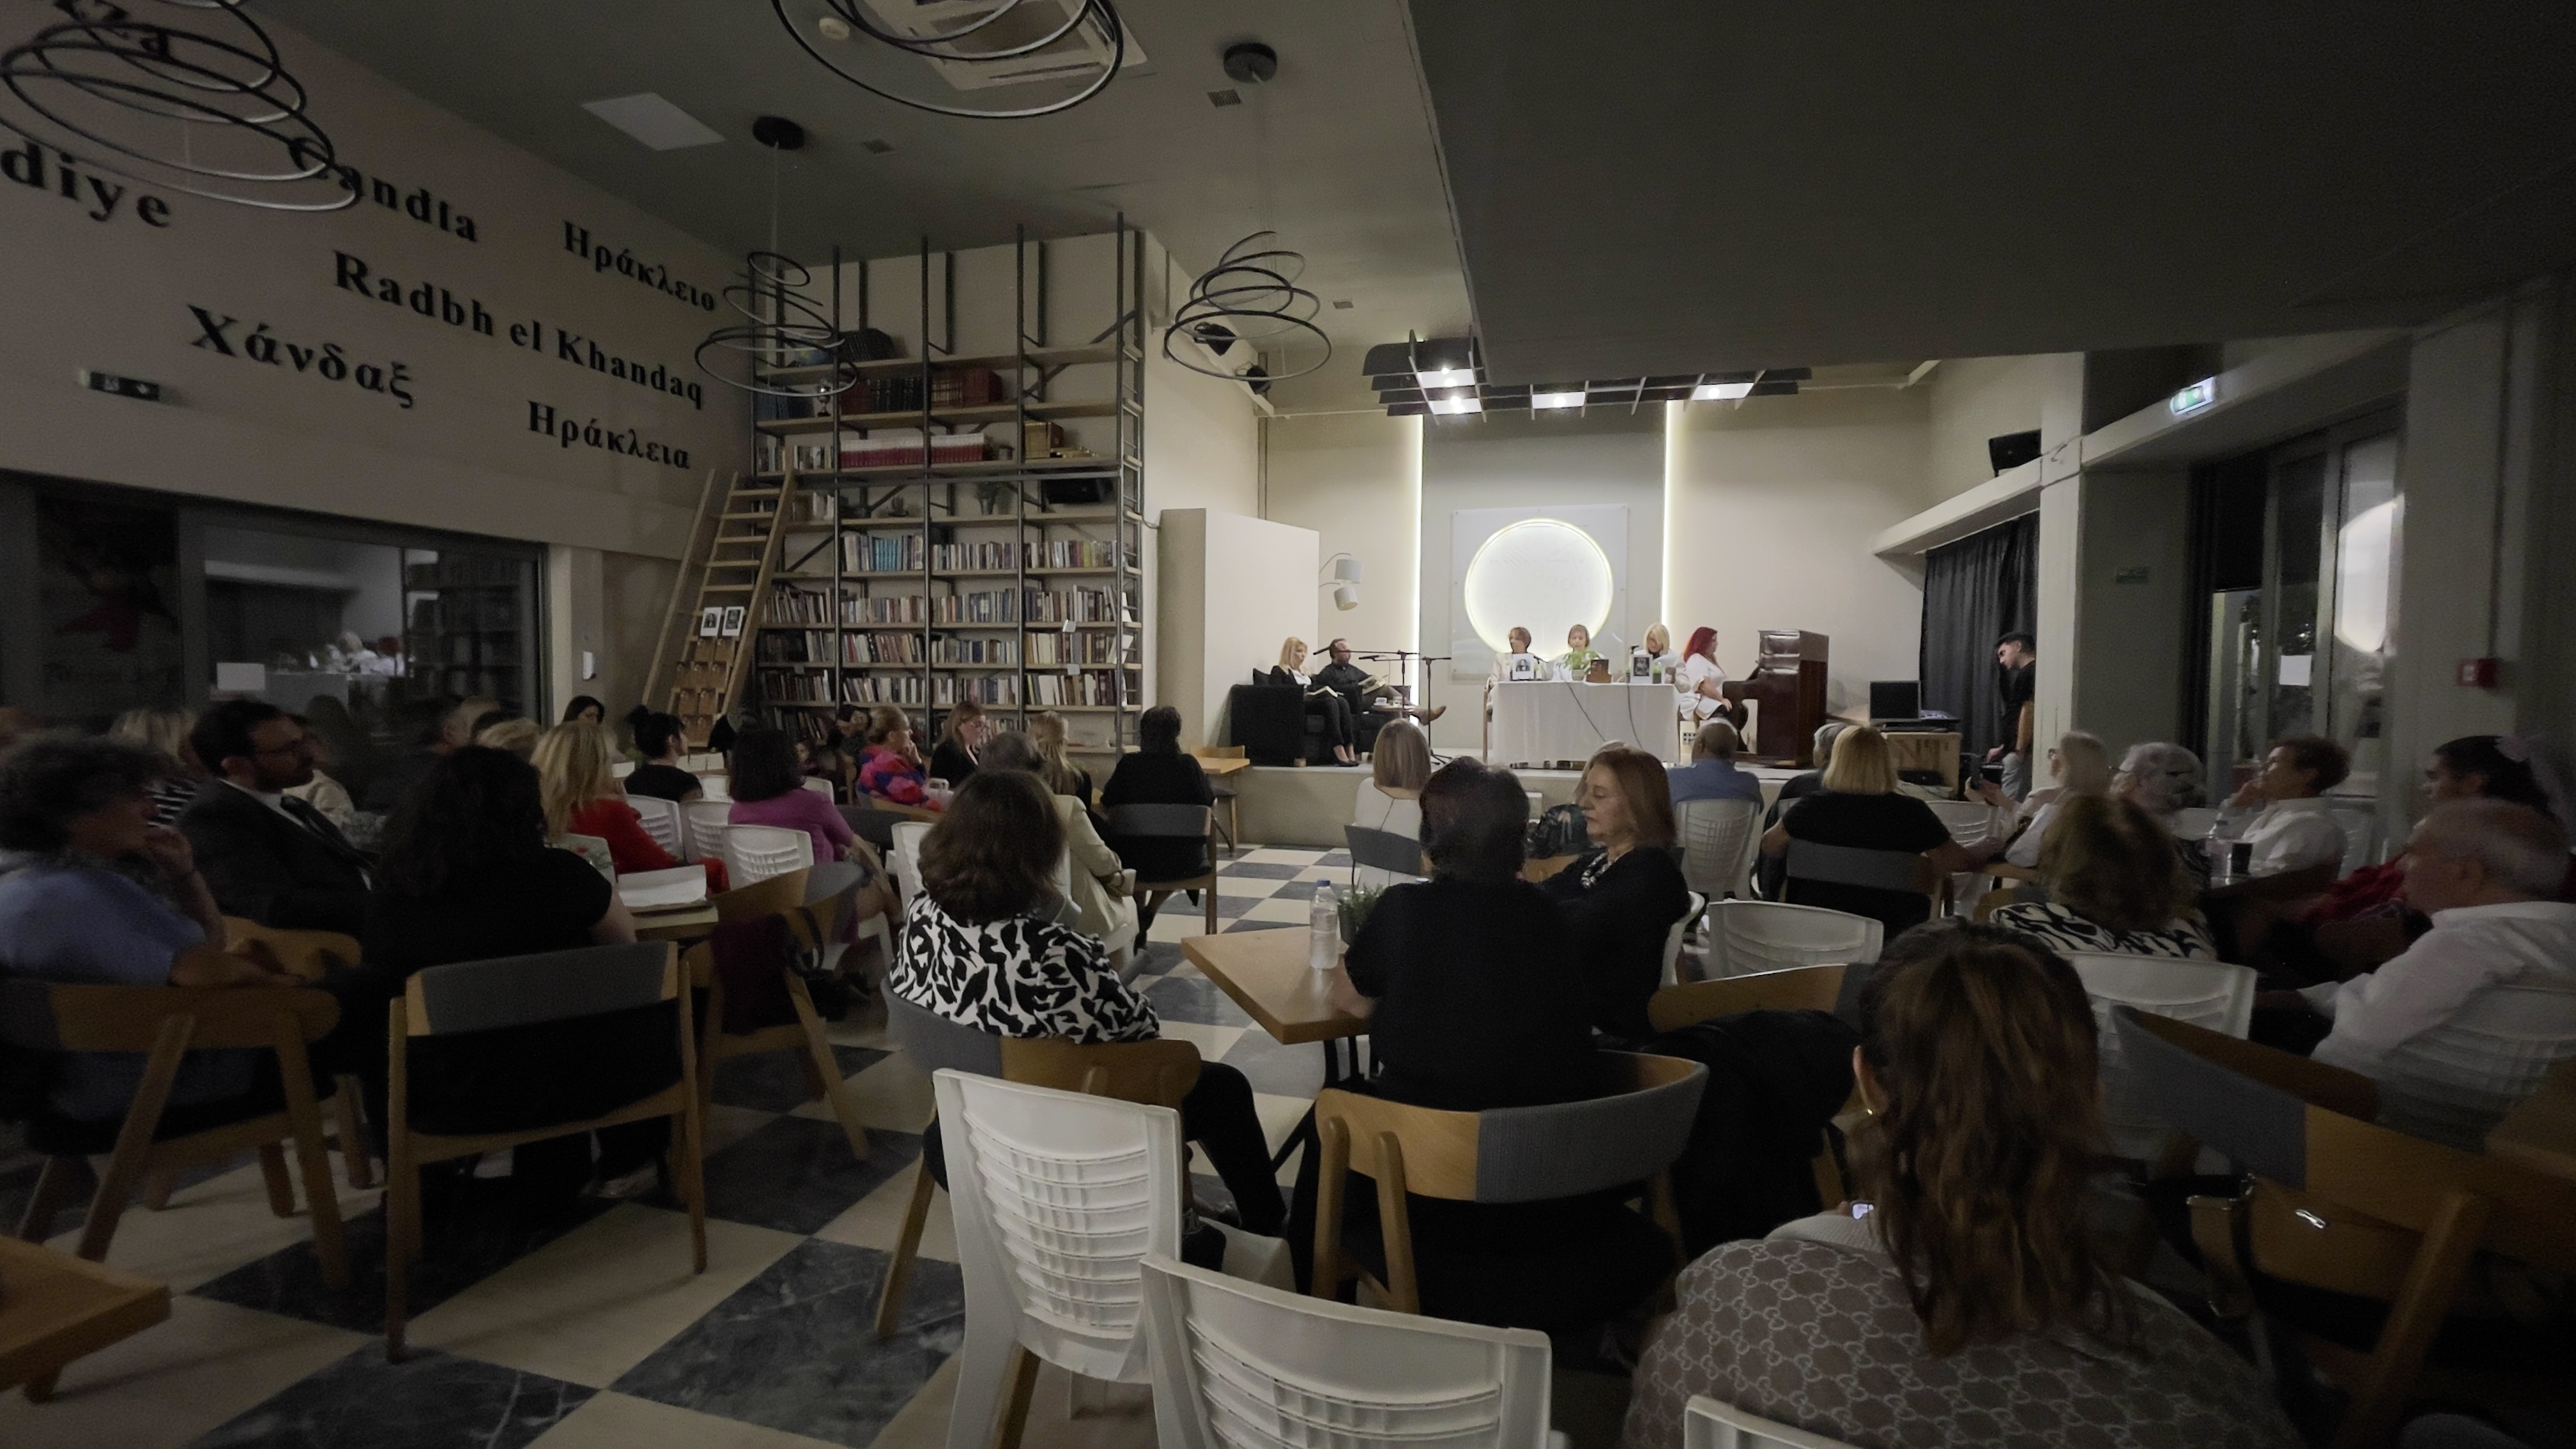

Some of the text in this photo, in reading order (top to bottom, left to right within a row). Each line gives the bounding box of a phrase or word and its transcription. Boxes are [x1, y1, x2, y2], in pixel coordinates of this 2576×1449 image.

[0, 140, 171, 228] diye
[562, 220, 716, 312] Ηράκλειο
[187, 303, 414, 410] Χάνδαξ
[332, 249, 703, 411] Radbh el Khandaq
[527, 400, 691, 470] Ηράκλεια
